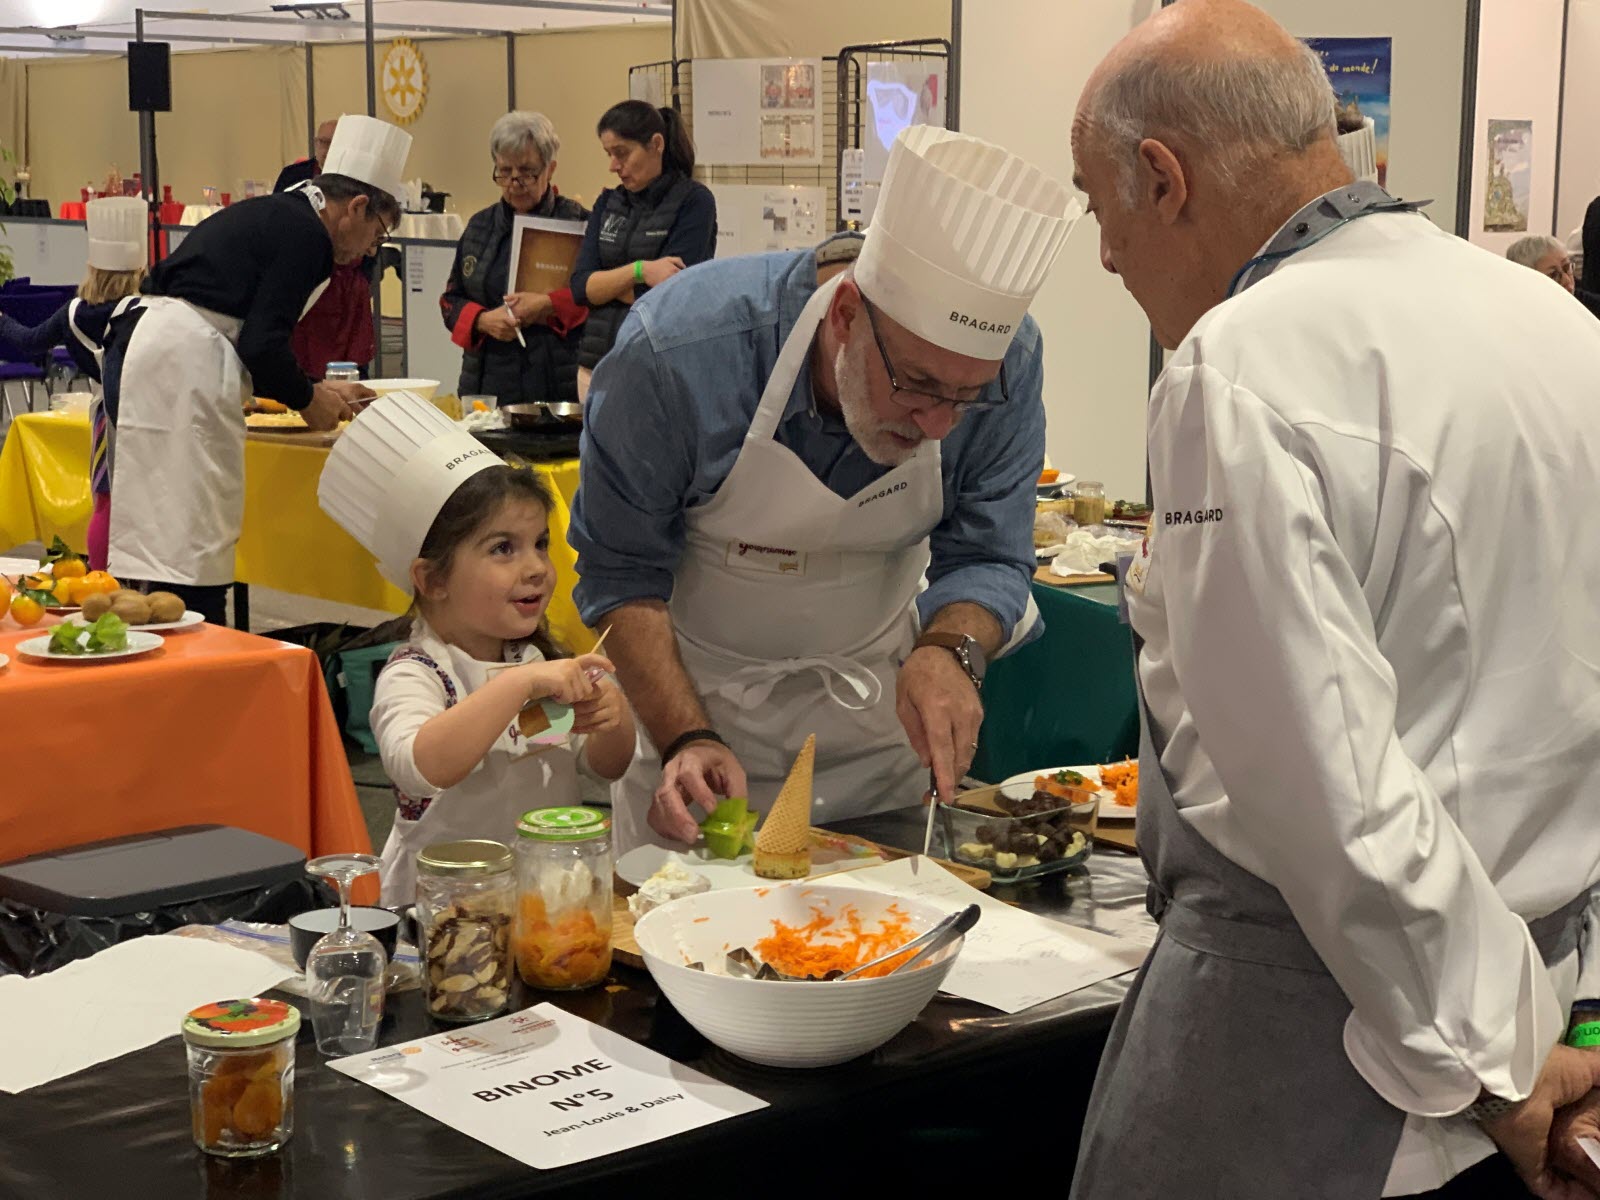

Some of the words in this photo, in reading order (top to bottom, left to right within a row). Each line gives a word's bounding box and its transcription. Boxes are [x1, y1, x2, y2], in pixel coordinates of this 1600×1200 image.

[949, 311, 1011, 335] BRAGARD
[858, 481, 908, 508] BRAGARD
[1165, 508, 1223, 525] BRAGARD
[472, 1058, 612, 1103] BINOME
[549, 1088, 614, 1112] N°5
[542, 1110, 625, 1137] Jean-Louis
[624, 1105, 641, 1114] &
[641, 1093, 685, 1109] Daisy
